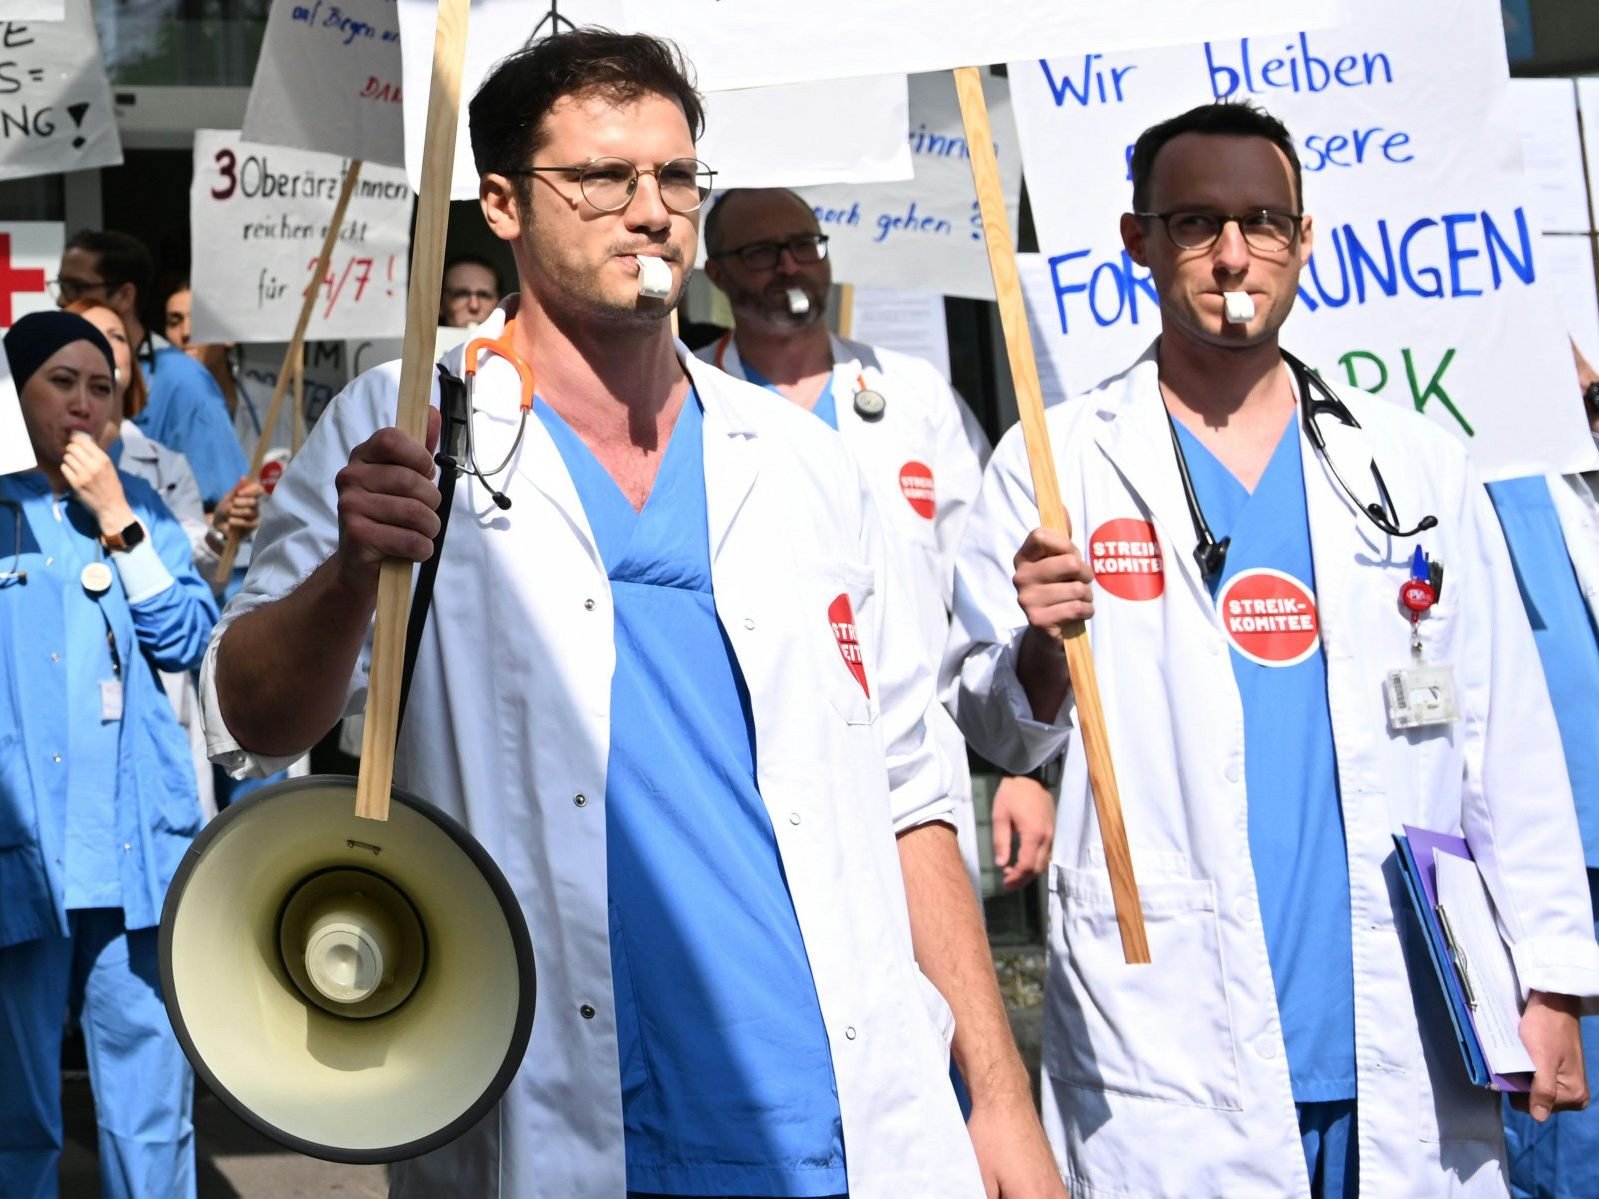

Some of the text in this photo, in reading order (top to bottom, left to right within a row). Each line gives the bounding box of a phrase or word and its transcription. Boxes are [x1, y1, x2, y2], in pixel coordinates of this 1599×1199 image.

[1038, 31, 1394, 107] Wir bleiben
[321, 220, 368, 242] ncht
[258, 267, 288, 309] für
[1229, 599, 1306, 615] STREIK-
[1229, 615, 1314, 632] KOMITEE
